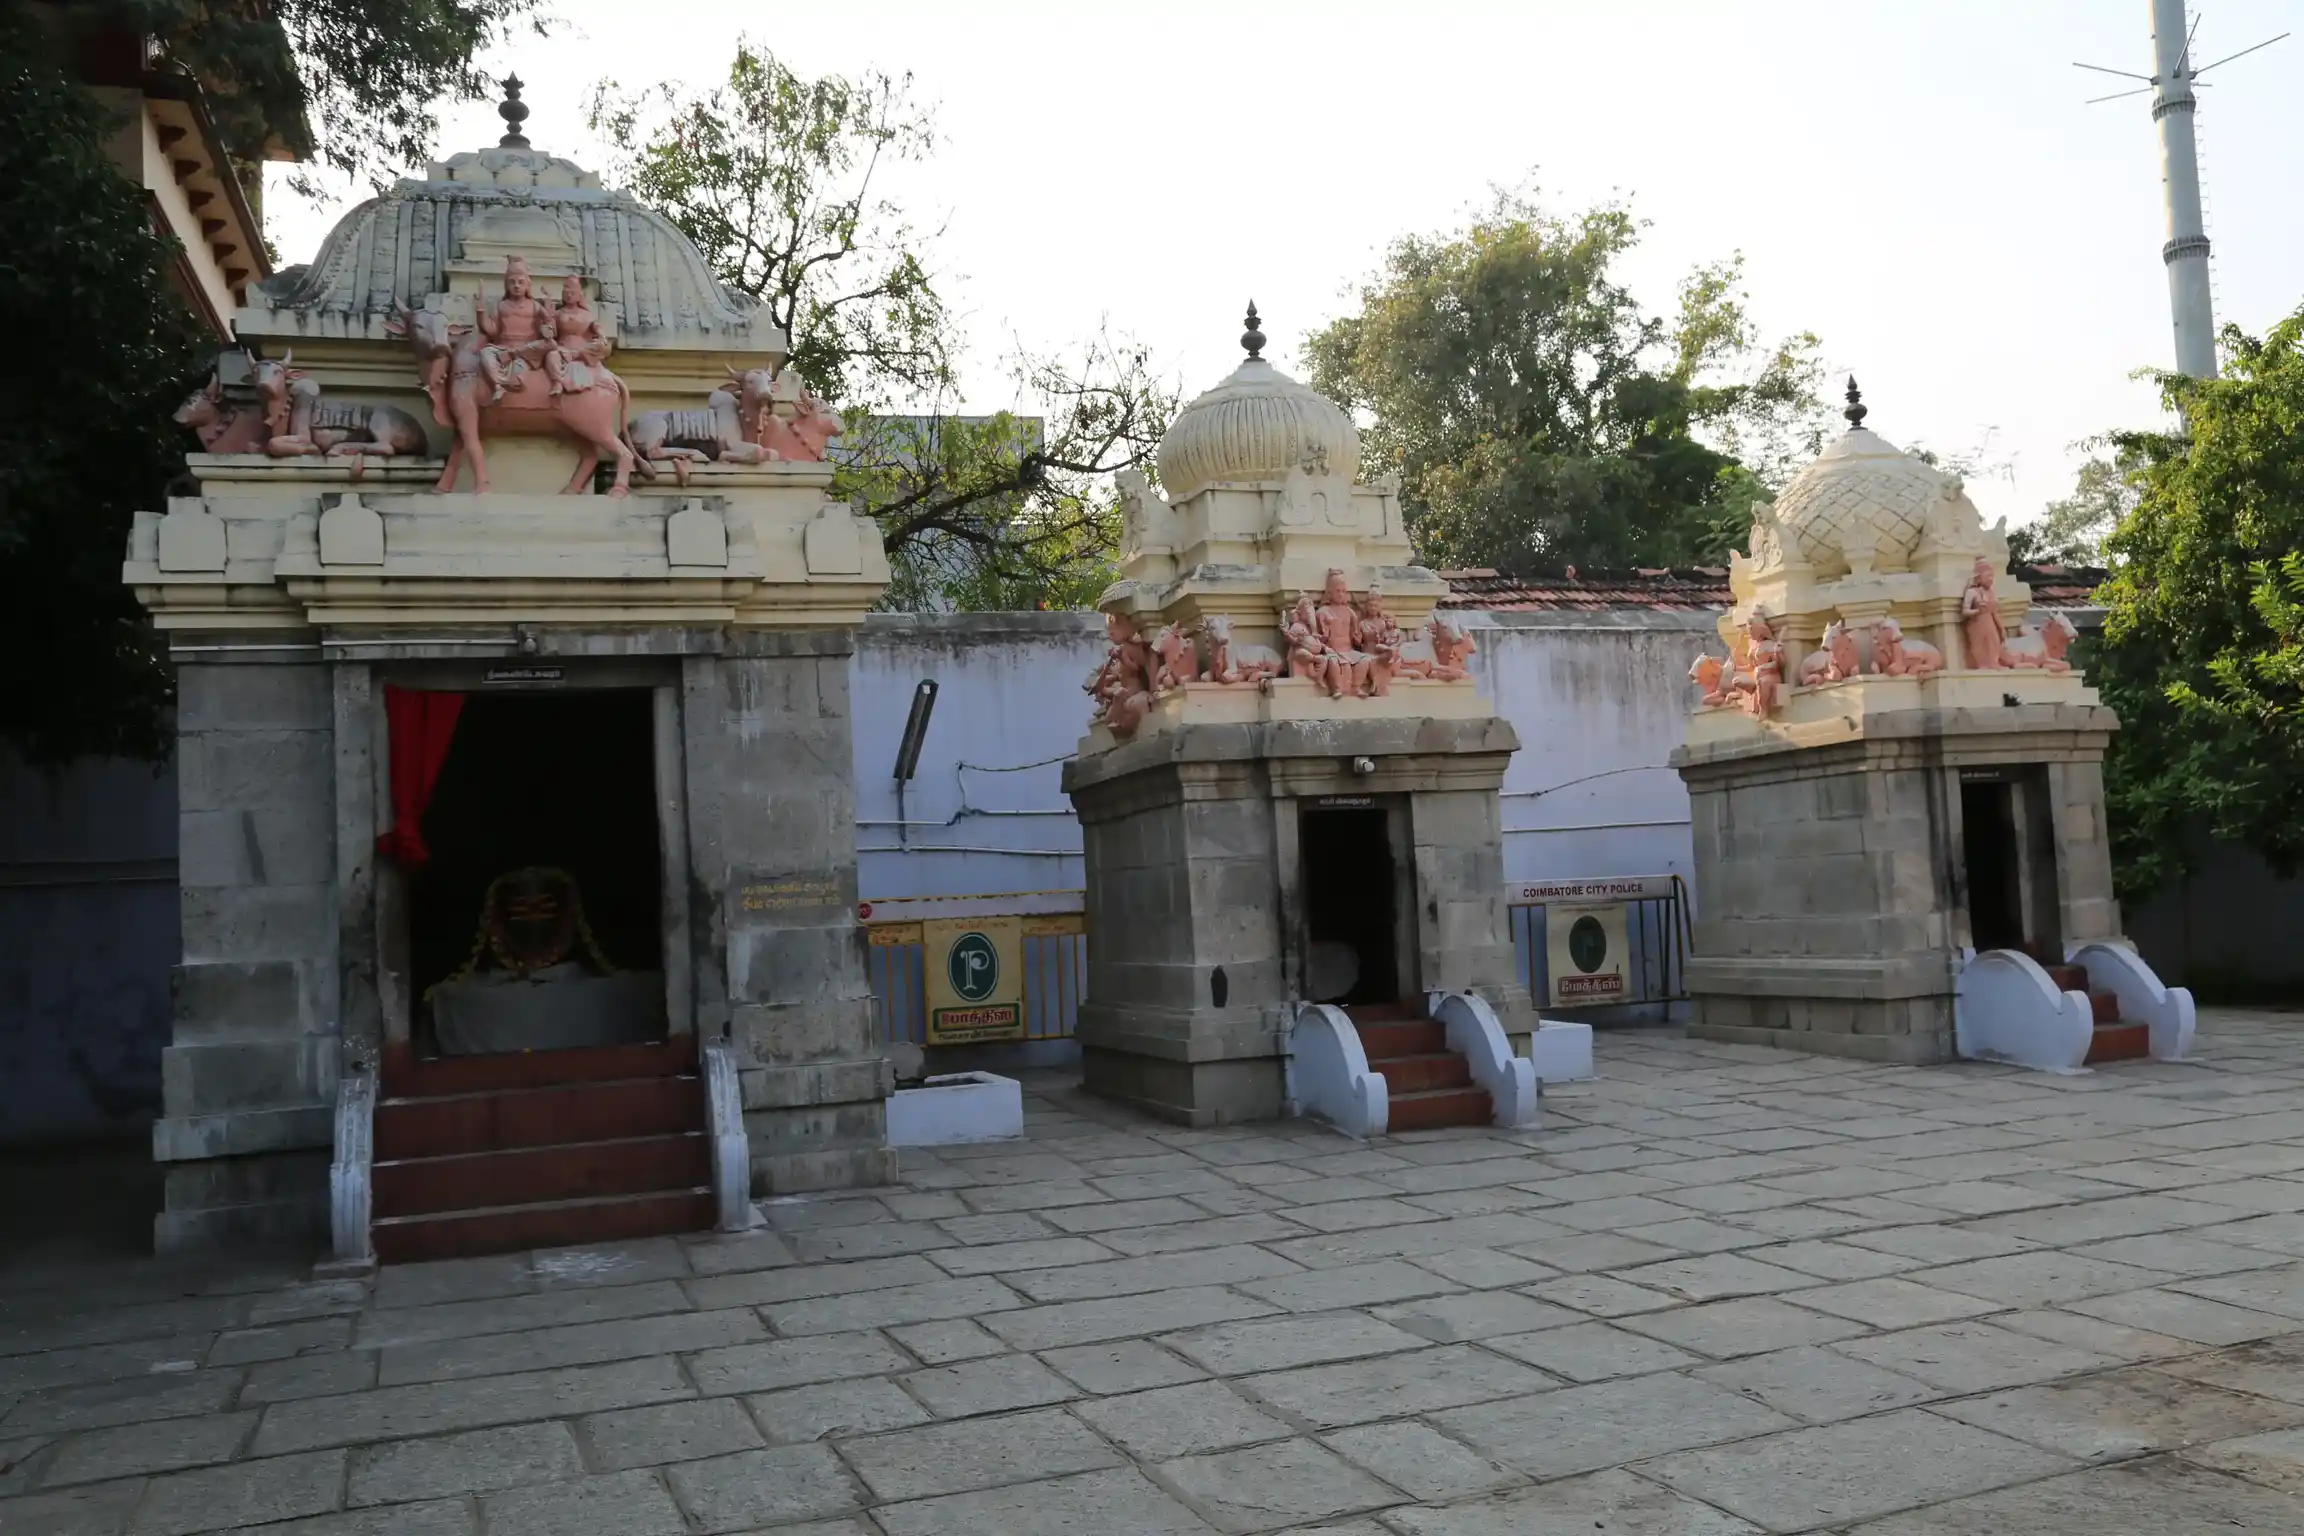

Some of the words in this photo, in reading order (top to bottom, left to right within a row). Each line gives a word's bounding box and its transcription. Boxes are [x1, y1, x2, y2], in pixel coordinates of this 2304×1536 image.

[1523, 886, 1584, 898] COIMBATORE
[1586, 885, 1608, 895] CITY
[1610, 883, 1643, 894] POLICE
